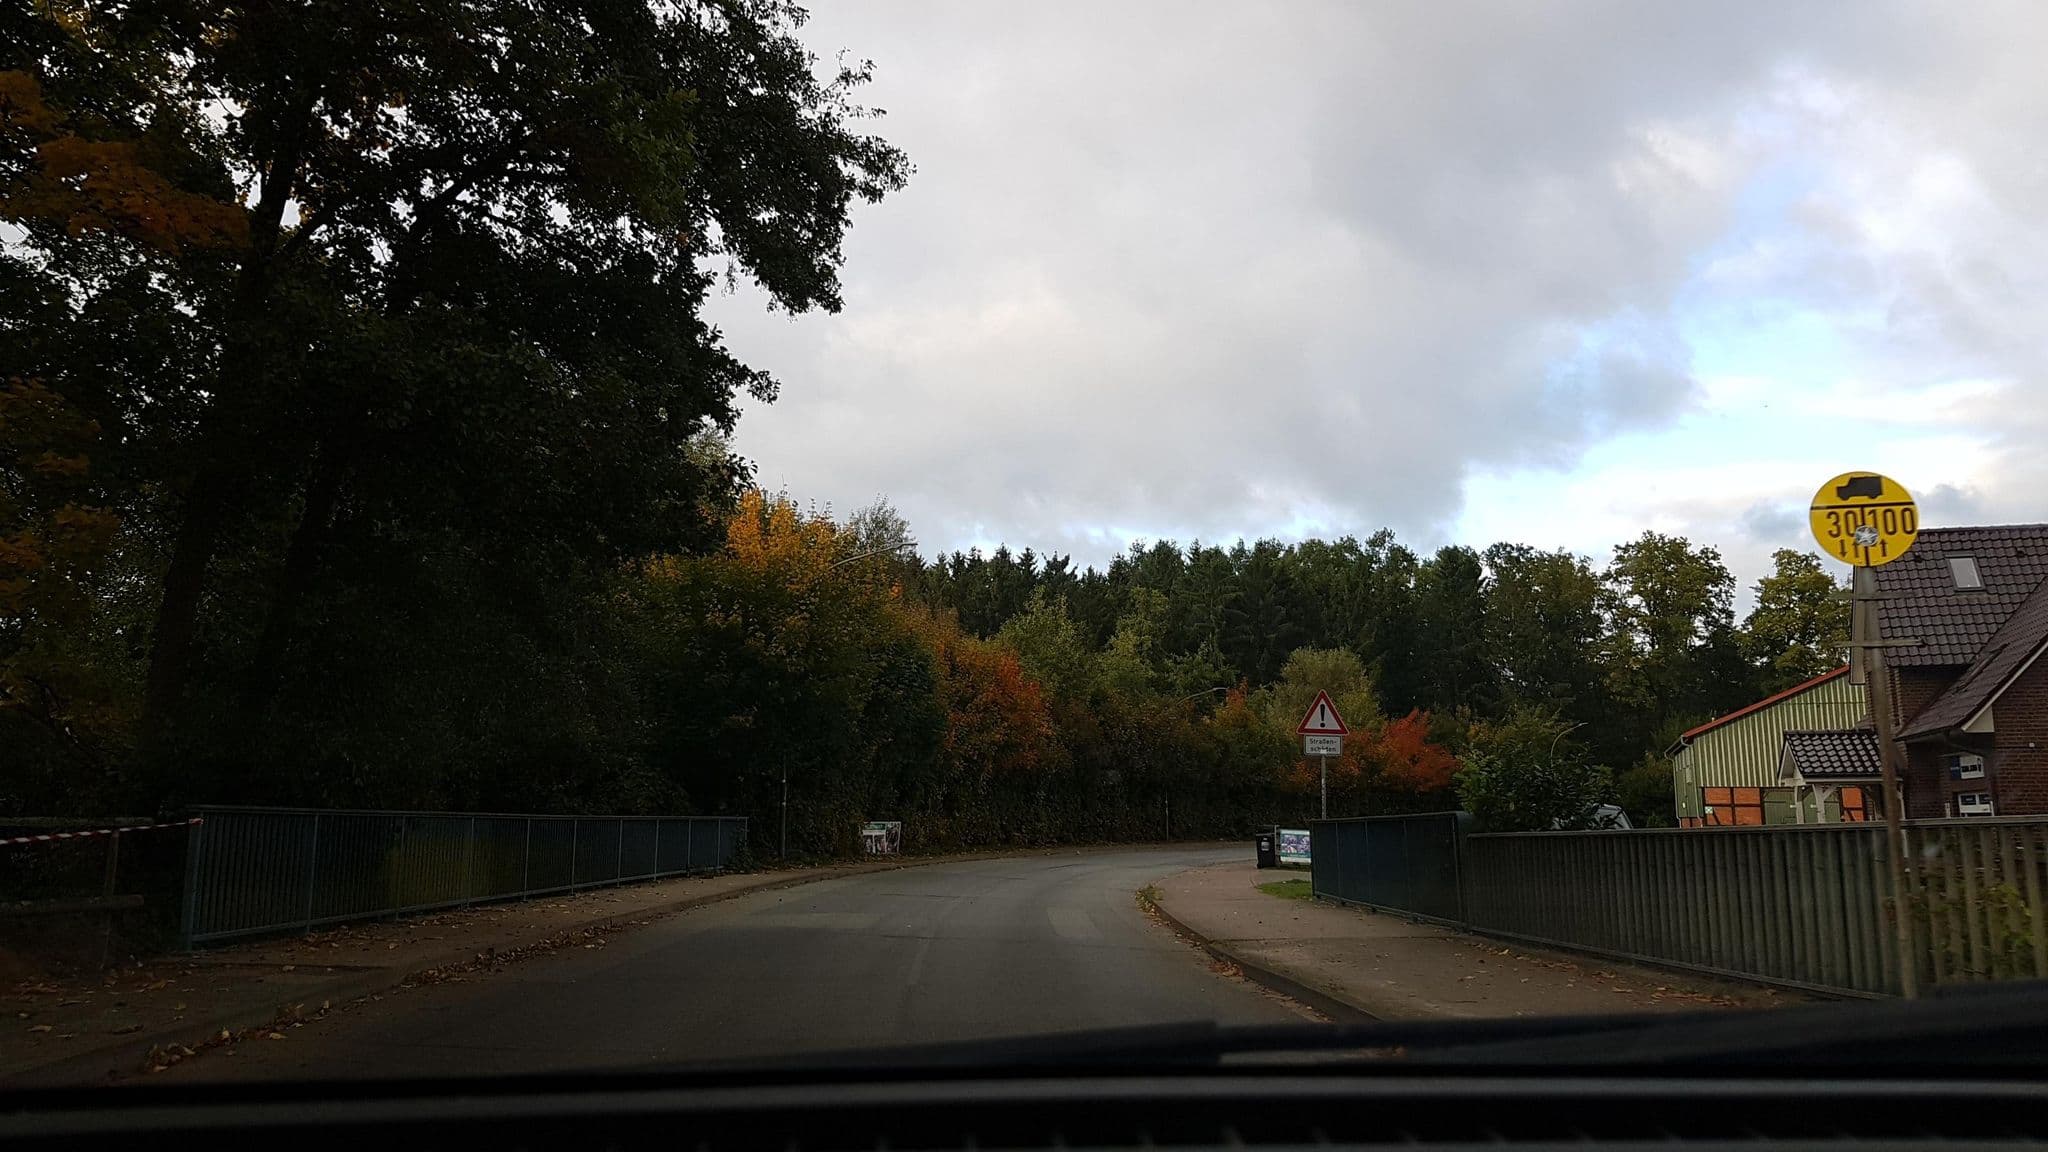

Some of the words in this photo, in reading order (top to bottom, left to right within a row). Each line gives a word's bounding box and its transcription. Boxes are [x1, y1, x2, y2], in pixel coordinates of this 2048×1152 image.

[1826, 510, 1858, 538] 30
[1867, 507, 1915, 535] 100
[1309, 737, 1337, 745] Straßen-
